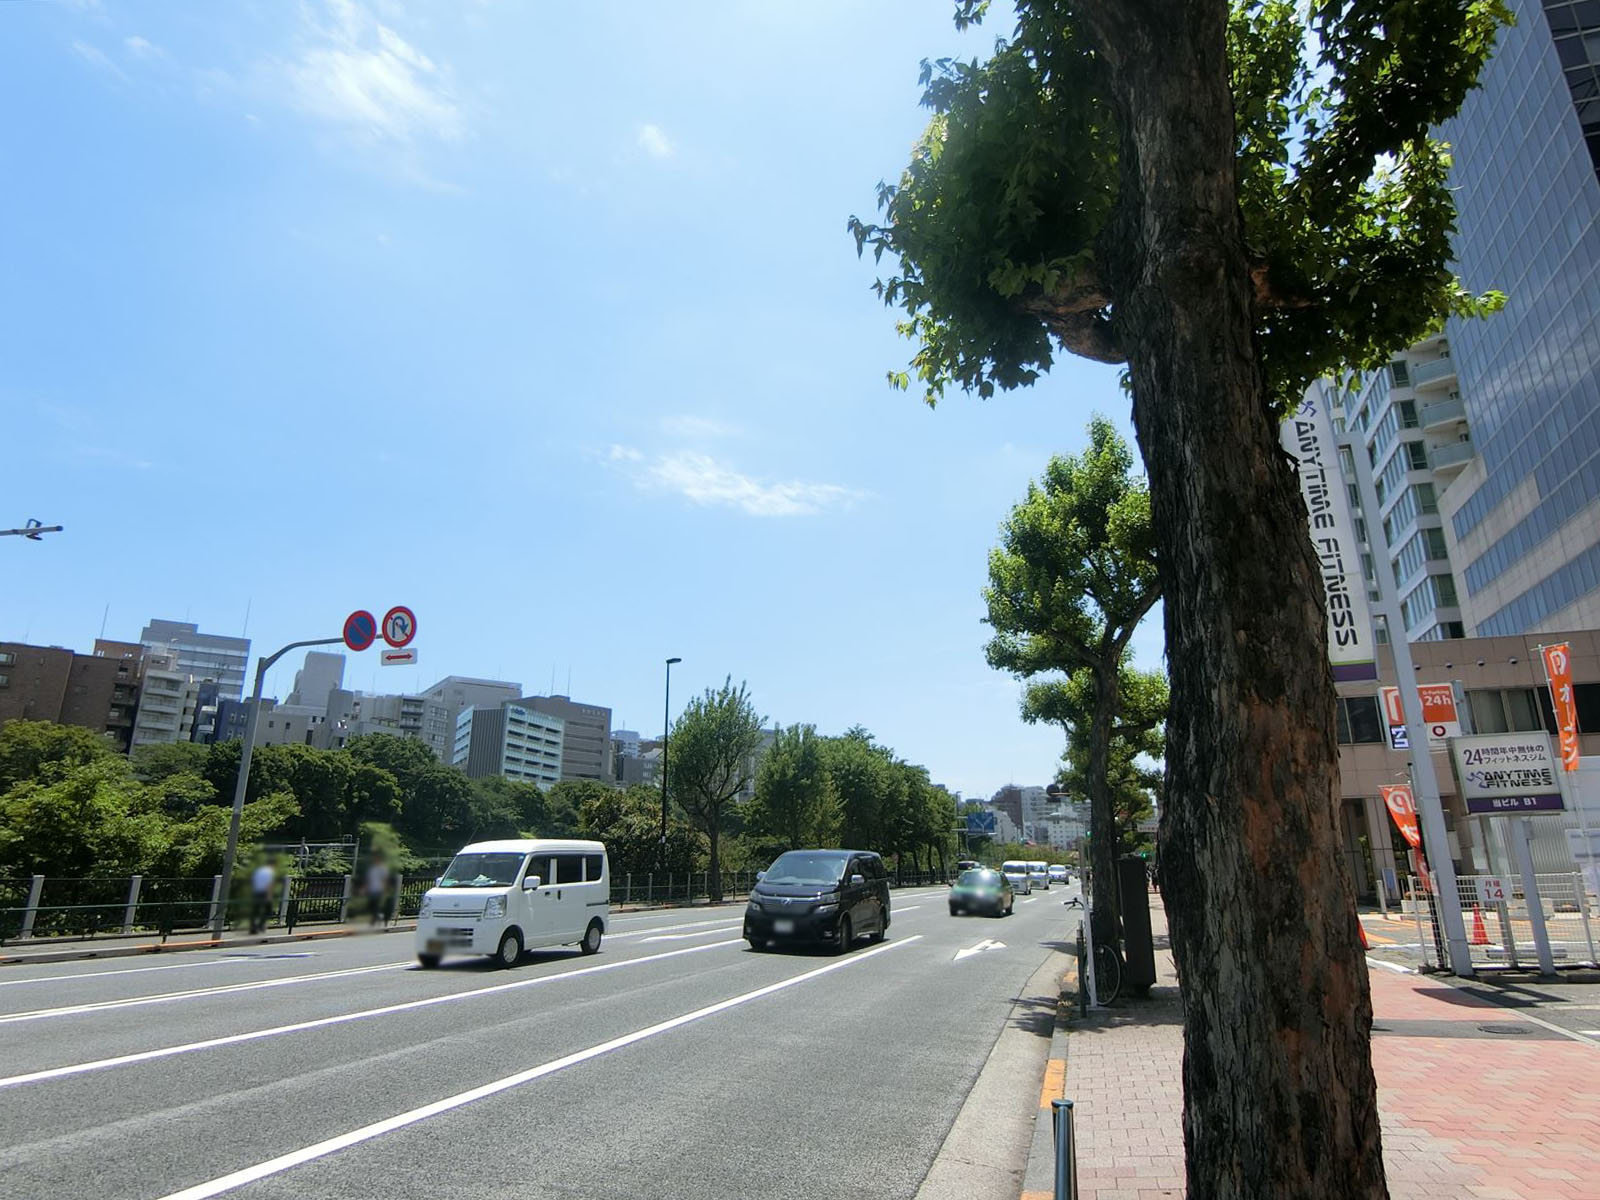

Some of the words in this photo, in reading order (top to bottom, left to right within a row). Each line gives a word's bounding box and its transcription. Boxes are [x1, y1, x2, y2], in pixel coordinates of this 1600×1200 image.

[1295, 421, 1335, 529] ANYTIME
[1318, 538, 1358, 646] FITNESS
[1423, 695, 1452, 706] 24h
[1484, 753, 1547, 765] フィットネスジム
[1484, 768, 1552, 781] ANYTIME
[1486, 778, 1553, 789] FITNESS
[1492, 798, 1519, 808] 当ビル
[1523, 797, 1537, 806] B1
[1484, 888, 1504, 900] 14
